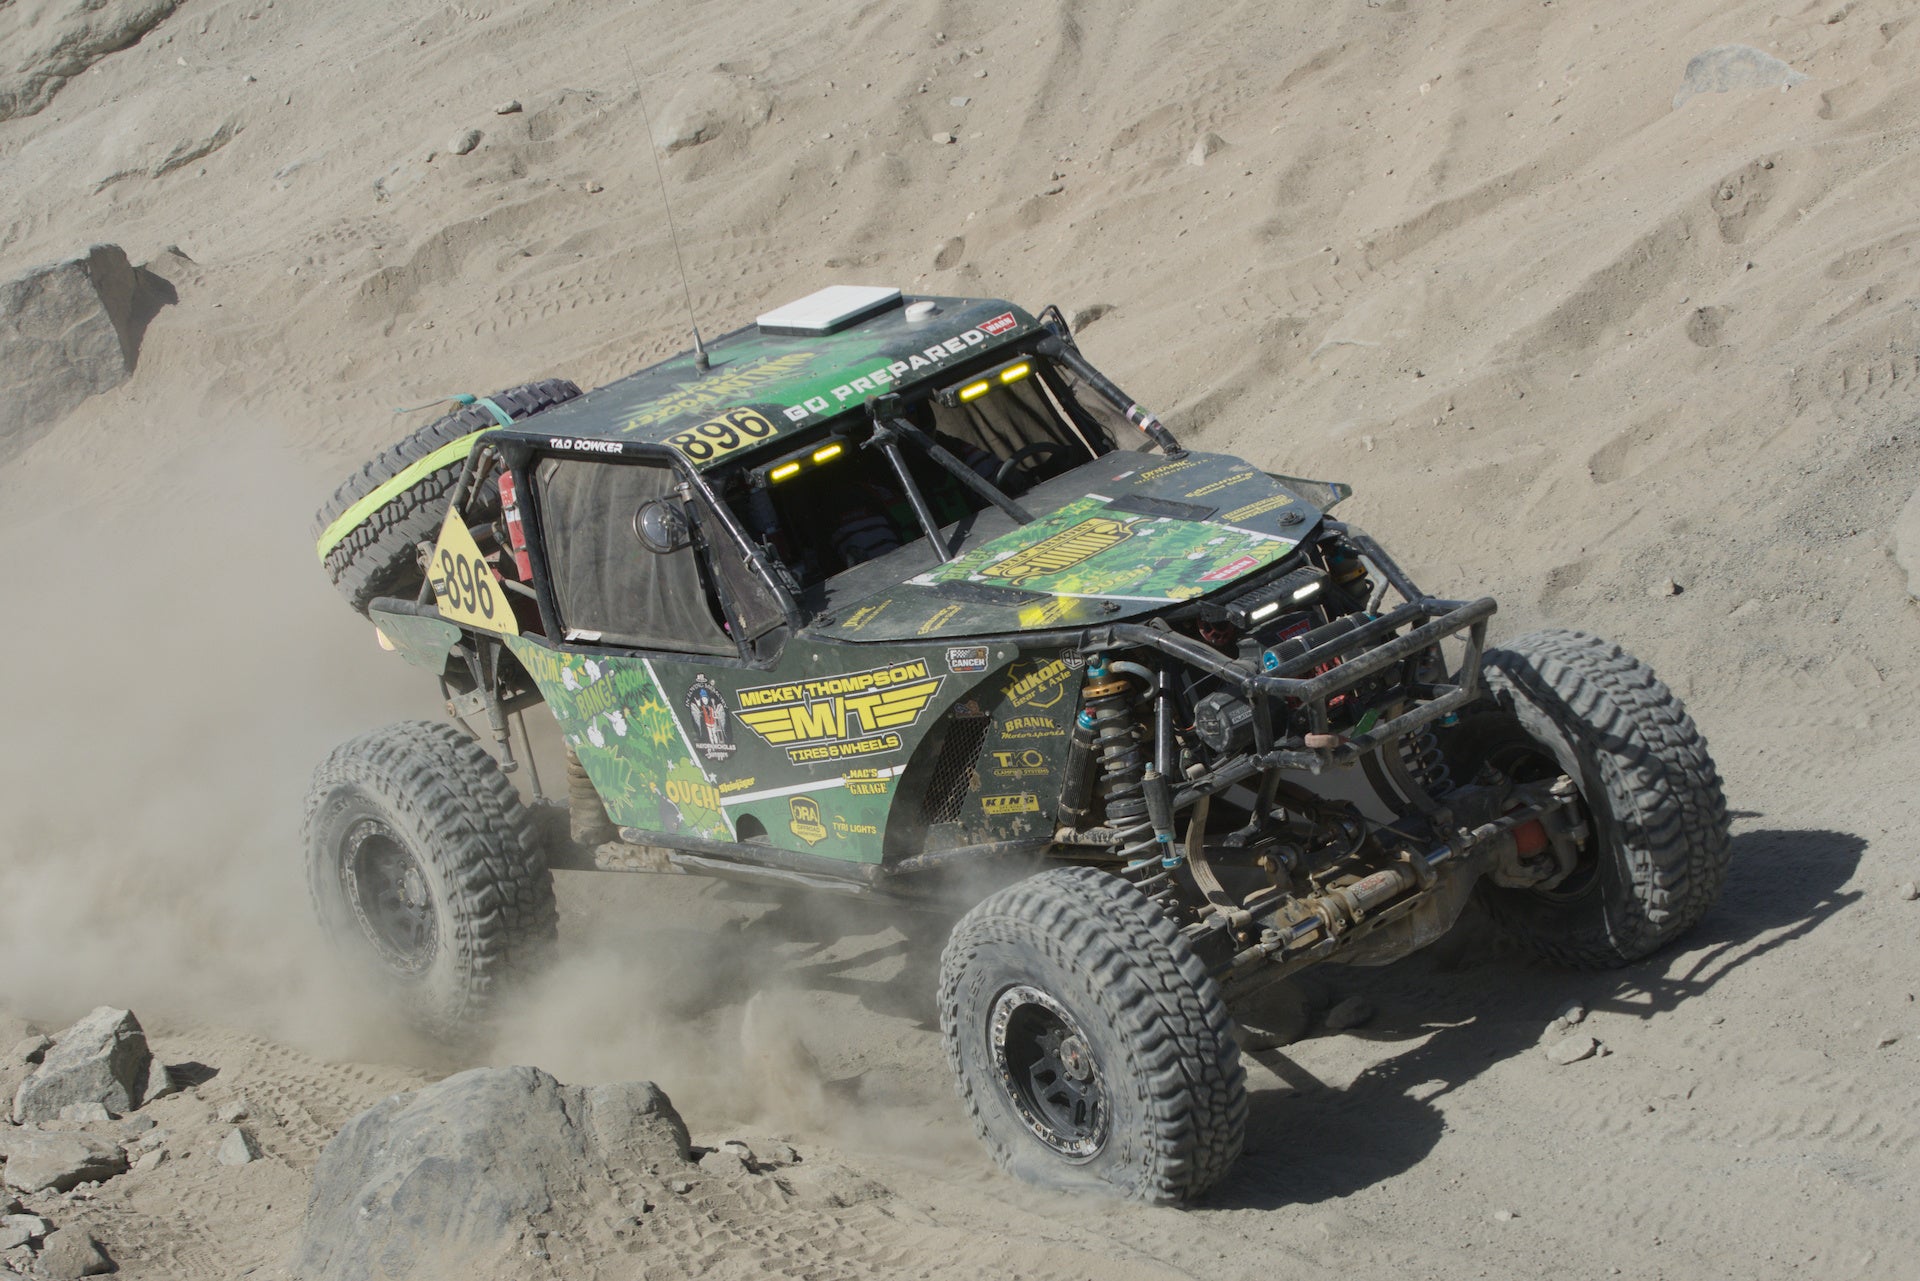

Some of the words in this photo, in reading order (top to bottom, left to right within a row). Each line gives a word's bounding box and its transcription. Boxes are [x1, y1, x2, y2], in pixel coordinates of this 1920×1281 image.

[783, 396, 829, 421] GO
[669, 411, 770, 459] 896
[996, 552, 1029, 571] JEEP
[441, 549, 494, 619] 896
[951, 659, 985, 668] CANCER
[739, 685, 804, 707] MICKEY
[805, 663, 926, 697] THOMPSON
[1001, 659, 1067, 700] Yukon
[1012, 692, 1035, 708] Gear
[1038, 684, 1048, 693] &
[1049, 670, 1071, 687] Axle
[576, 673, 616, 721] BANG!
[1001, 730, 1065, 739] Motorsports
[1005, 717, 1055, 732] BRANIK
[789, 746, 828, 761] TIRES
[829, 745, 839, 756] &
[839, 736, 899, 755] WHEELS
[993, 750, 1043, 767] TKO
[666, 781, 721, 814] OUCH!
[850, 783, 887, 795] GARAGE
[850, 825, 876, 834] LIGHTS
